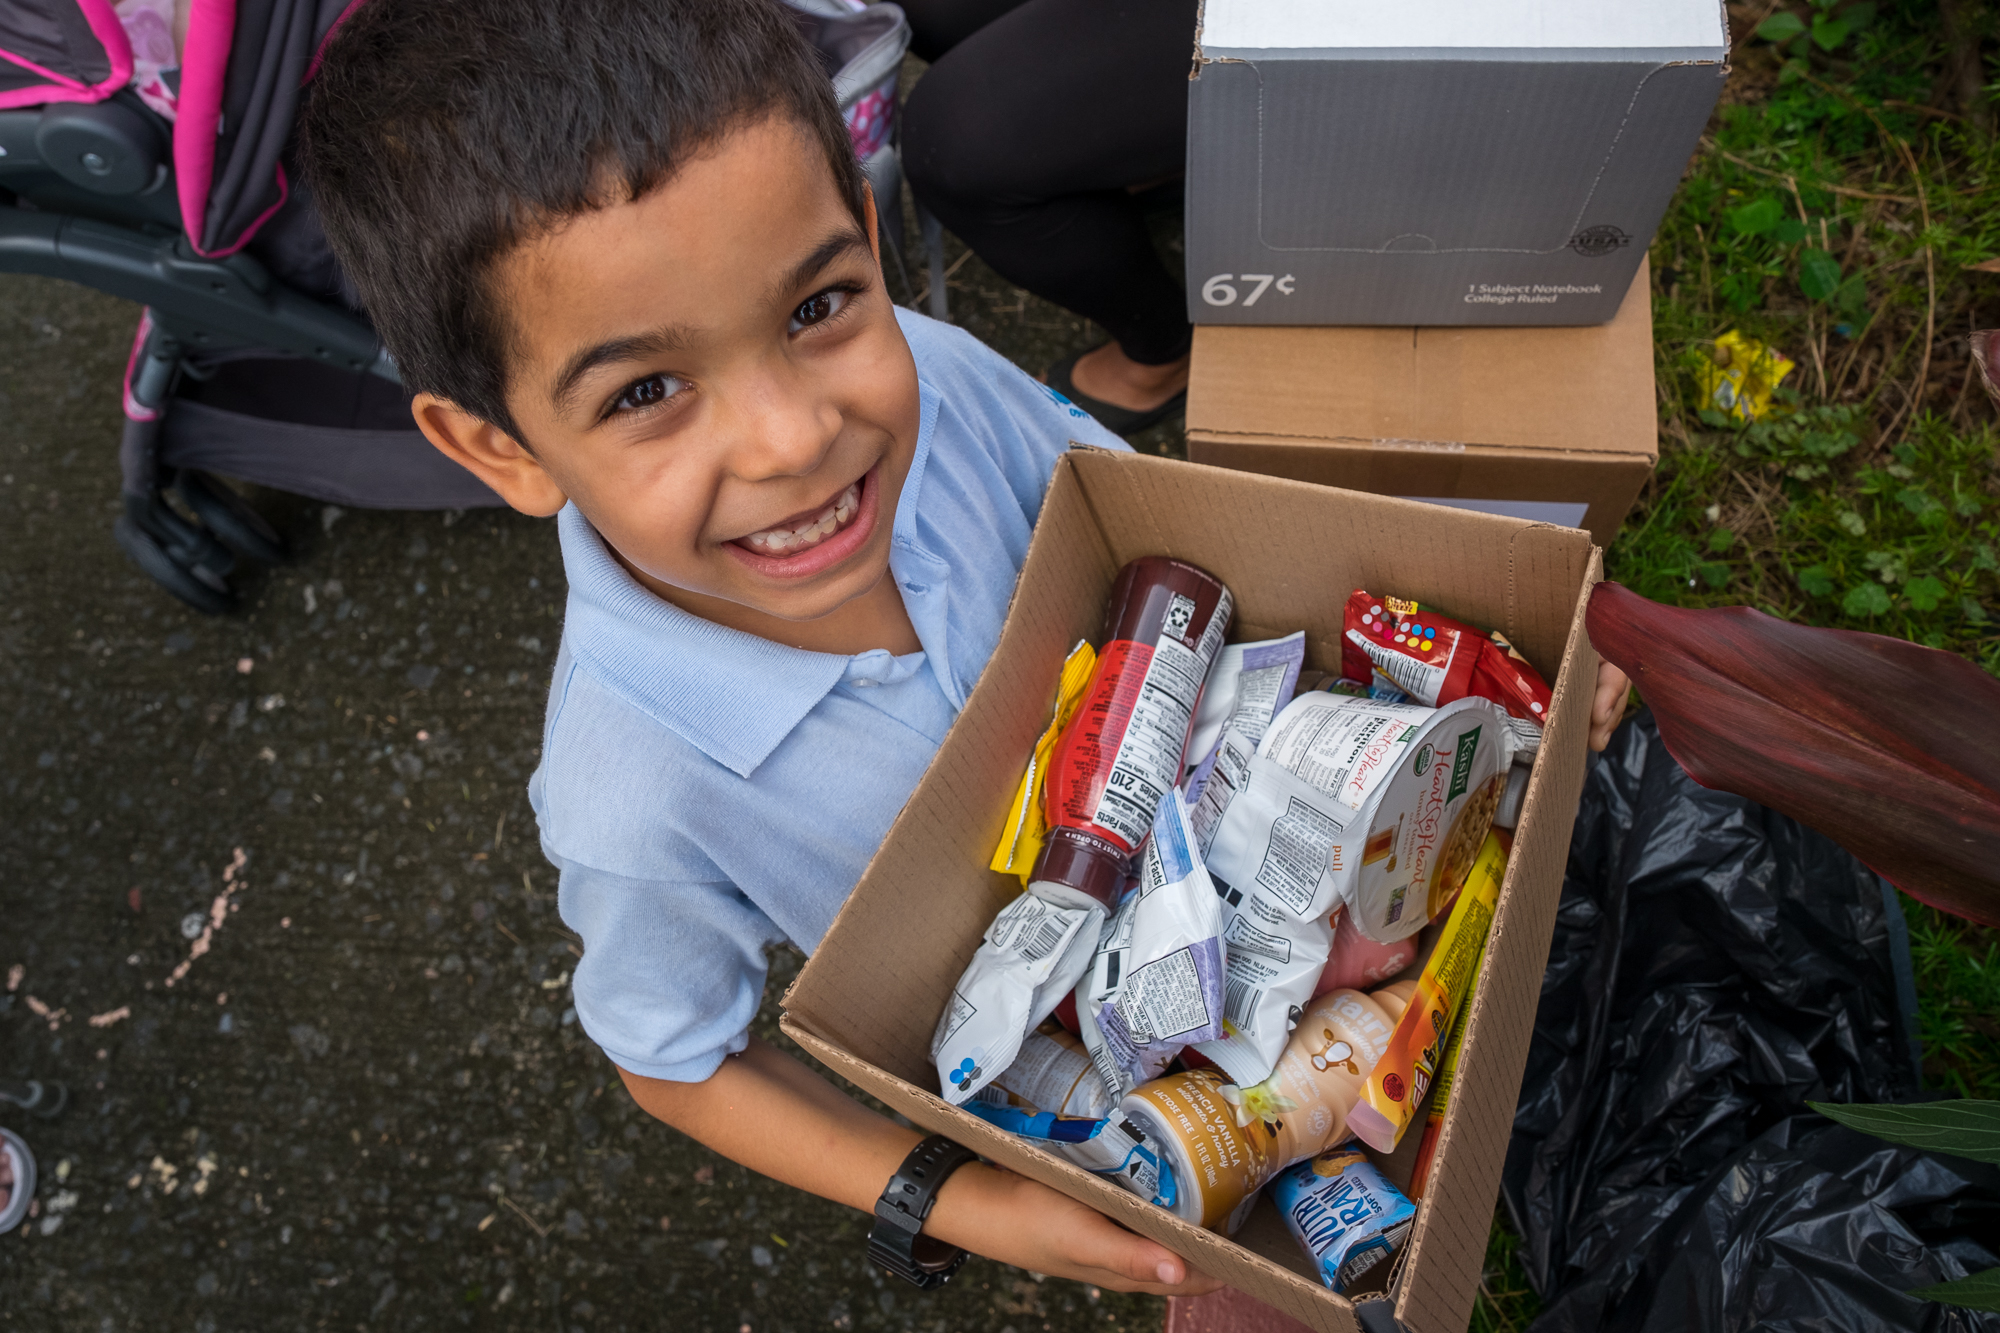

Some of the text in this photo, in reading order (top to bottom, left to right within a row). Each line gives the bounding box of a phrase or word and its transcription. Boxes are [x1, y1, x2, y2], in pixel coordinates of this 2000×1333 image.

[1202, 273, 1295, 306] 67¢
[1464, 294, 1557, 304] College Ruled
[1468, 284, 1602, 294] 1 Subject Notebook
[1346, 717, 1386, 763] Nutrition
[1353, 716, 1379, 743] Facts
[1349, 719, 1408, 790] Heart to Heart
[1453, 734, 1474, 791] Kashi
[1109, 769, 1135, 791] 210
[1096, 810, 1119, 829] Facts
[1404, 788, 1426, 870] honey toasted
[1407, 748, 1451, 897] Heart to Heart
[1070, 831, 1121, 858] TWIST TO OPEN
[1332, 845, 1343, 872] pull
[1150, 859, 1162, 885] Facts
[1175, 1086, 1229, 1168] with oats & honey
[1182, 1080, 1240, 1167] FRENCH VANILLA
[1313, 1110, 1326, 1128] 40
[1152, 1087, 1218, 1188] LACTOSE FREE 8 FL OZ (240mL)
[1135, 1175, 1145, 1184] AND
[1138, 1170, 1149, 1179] LIFT
[1350, 1175, 1383, 1213] SOFT BAKED
[1290, 1193, 1346, 1256] NUTRI
